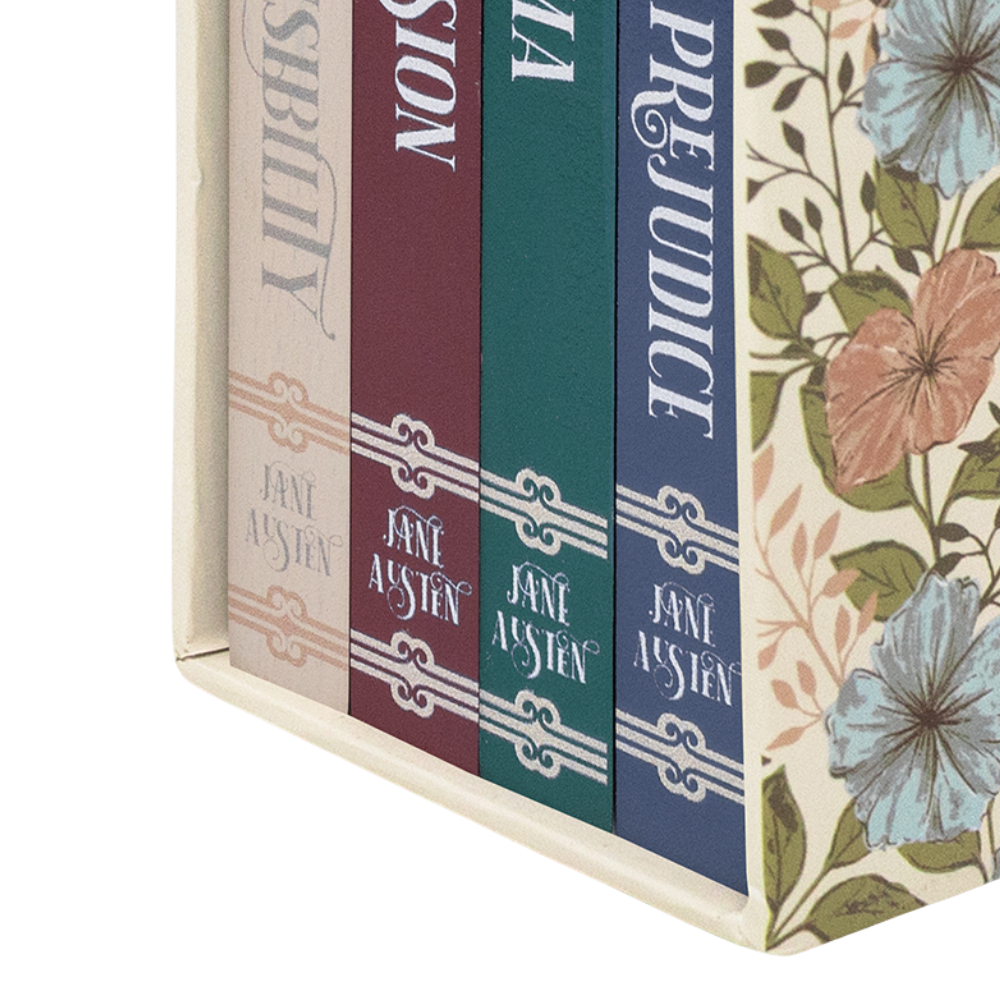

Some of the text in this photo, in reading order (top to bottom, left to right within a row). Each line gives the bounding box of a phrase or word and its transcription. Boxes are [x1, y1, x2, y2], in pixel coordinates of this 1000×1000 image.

[631, 1, 715, 440] PREJUDICE
[259, 460, 316, 520] JANE
[245, 511, 343, 577] AUSTEN
[383, 504, 445, 568] JANE
[368, 553, 472, 626] AUSTEN
[506, 561, 571, 627] JANE
[649, 581, 717, 648] JANE
[491, 610, 600, 684] AUSTEN
[633, 630, 742, 706] AUSTEN
